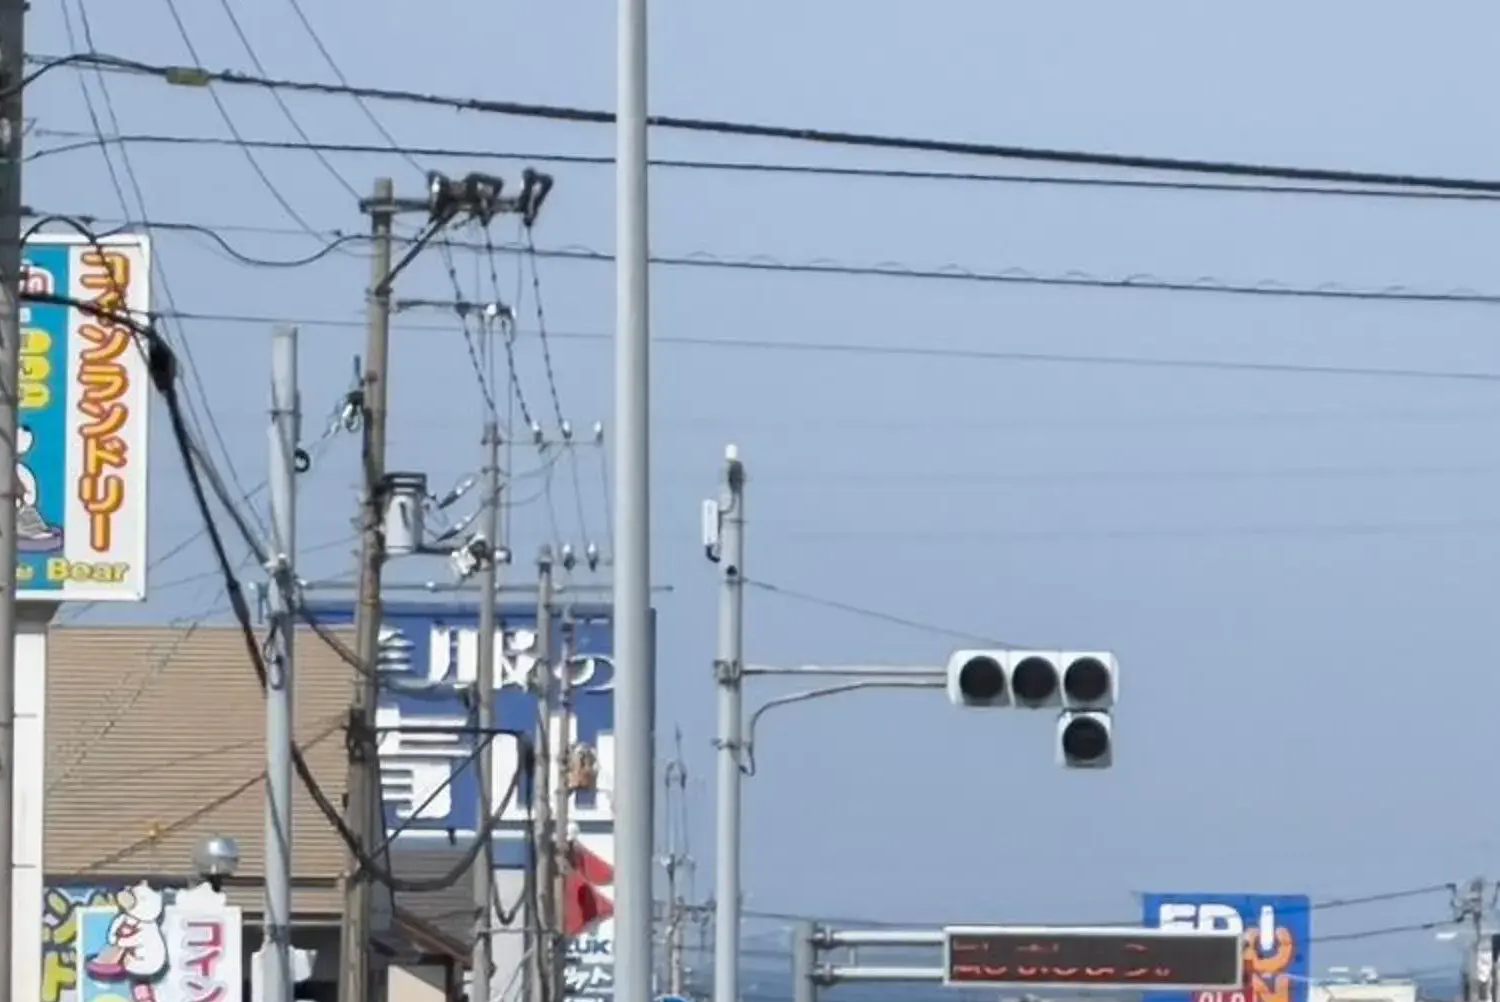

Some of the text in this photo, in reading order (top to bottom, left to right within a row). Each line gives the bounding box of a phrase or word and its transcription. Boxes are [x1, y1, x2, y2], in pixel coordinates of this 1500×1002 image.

[77, 251, 131, 552] コインランドリー
[46, 557, 130, 582] Bear
